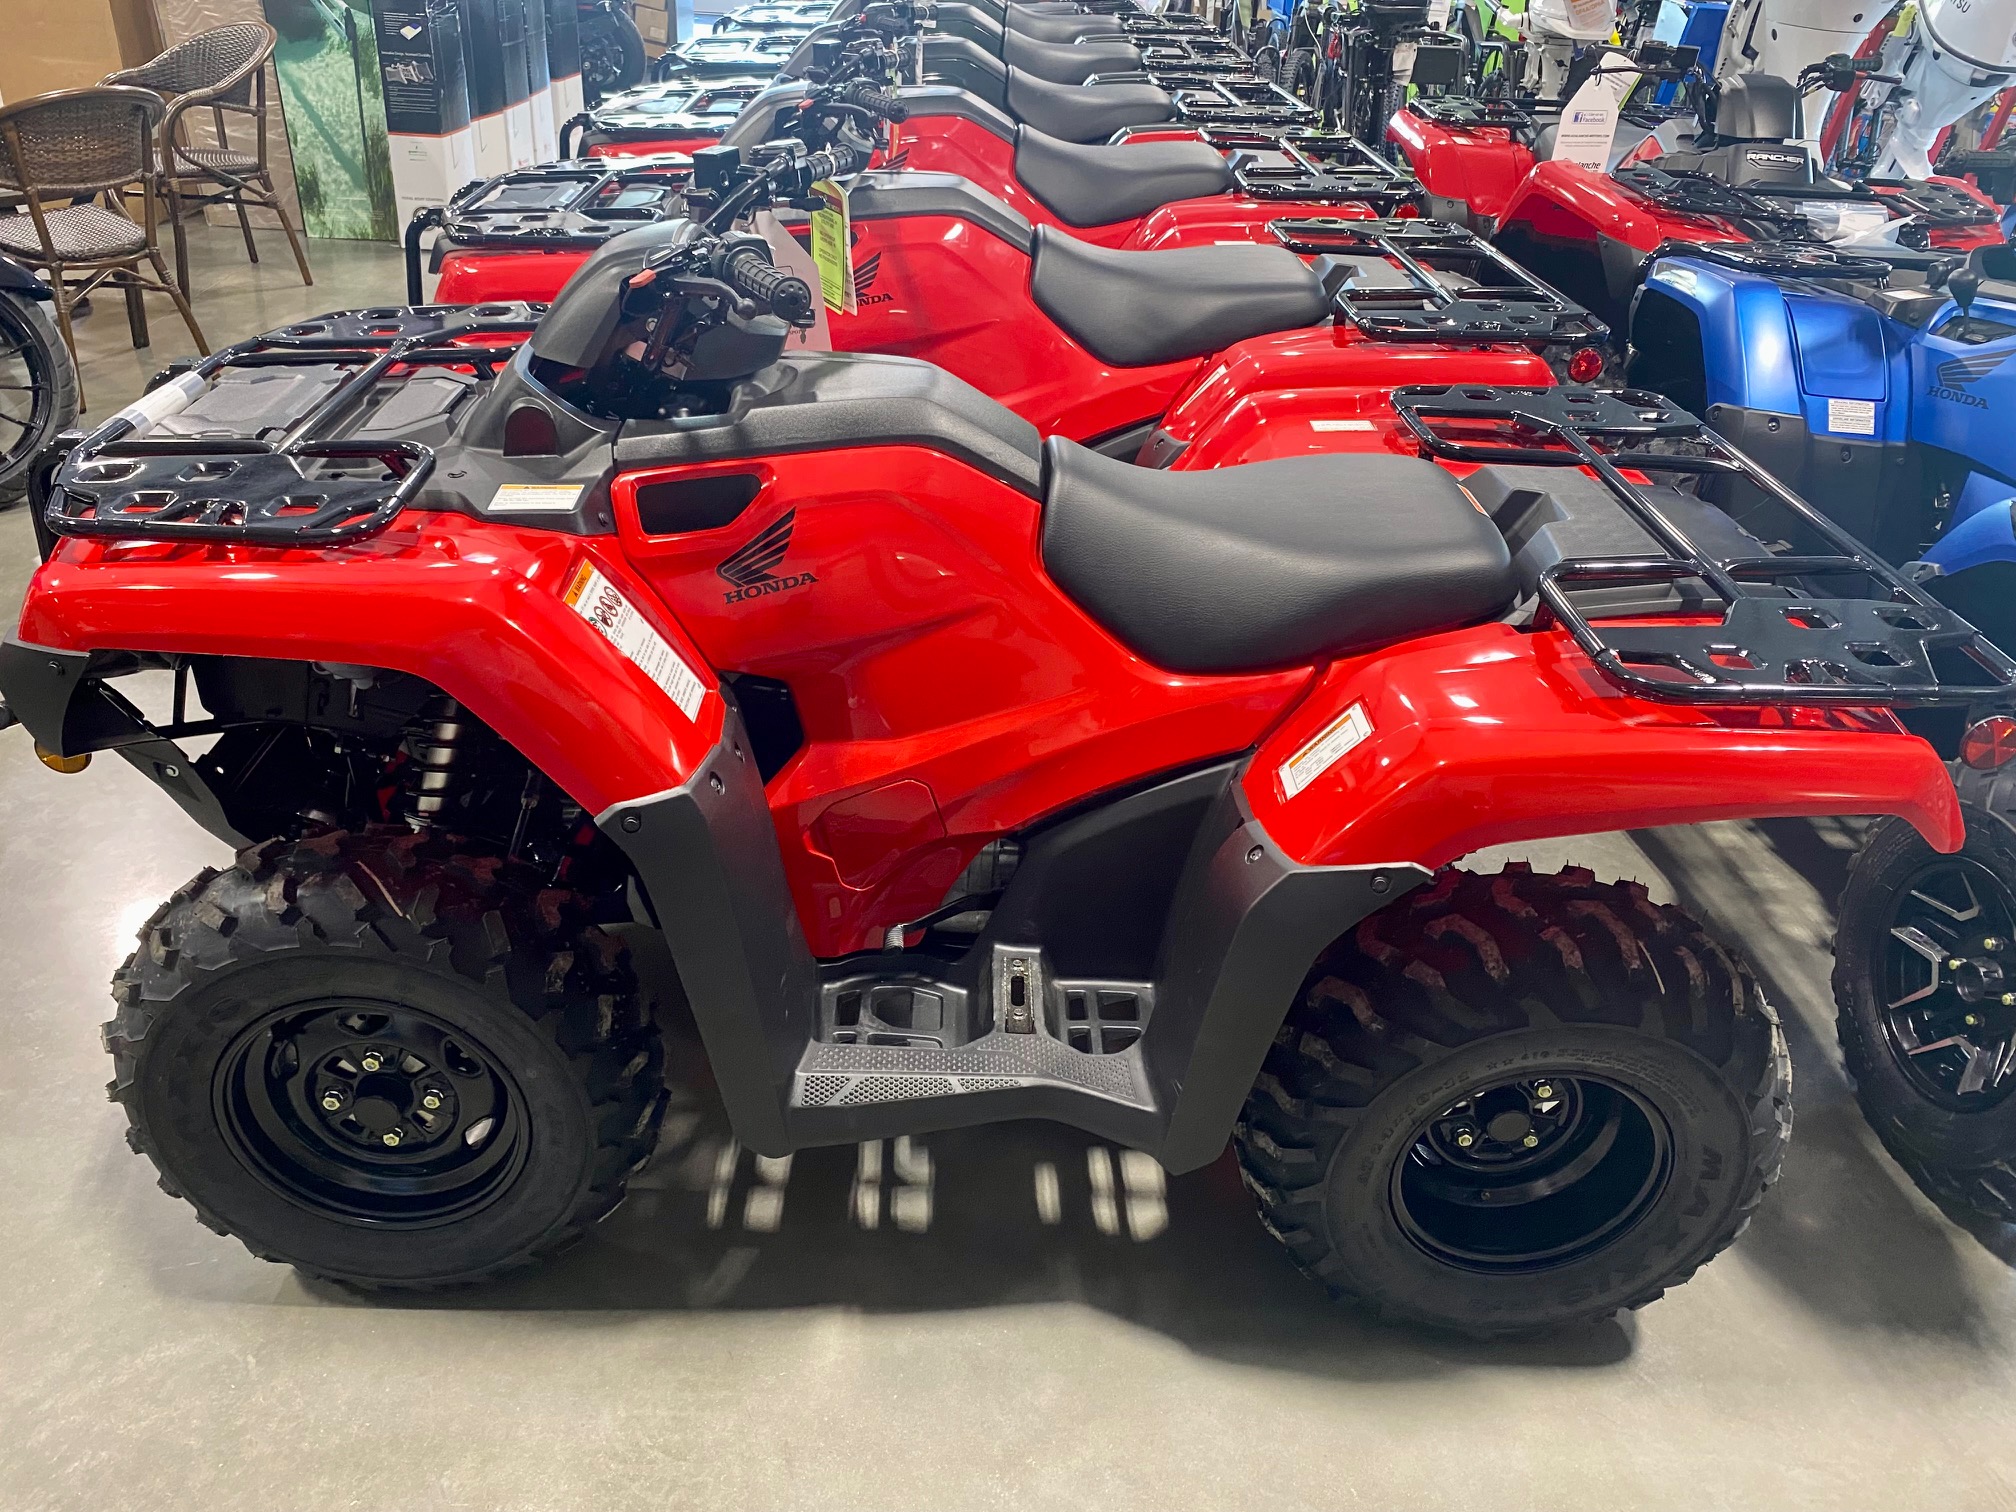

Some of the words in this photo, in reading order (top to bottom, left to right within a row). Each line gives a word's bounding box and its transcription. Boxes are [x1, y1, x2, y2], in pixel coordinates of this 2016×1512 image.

[1746, 153, 1805, 165] RANCHER
[1926, 385, 1989, 410] HONDA
[722, 572, 819, 605] HONDA
